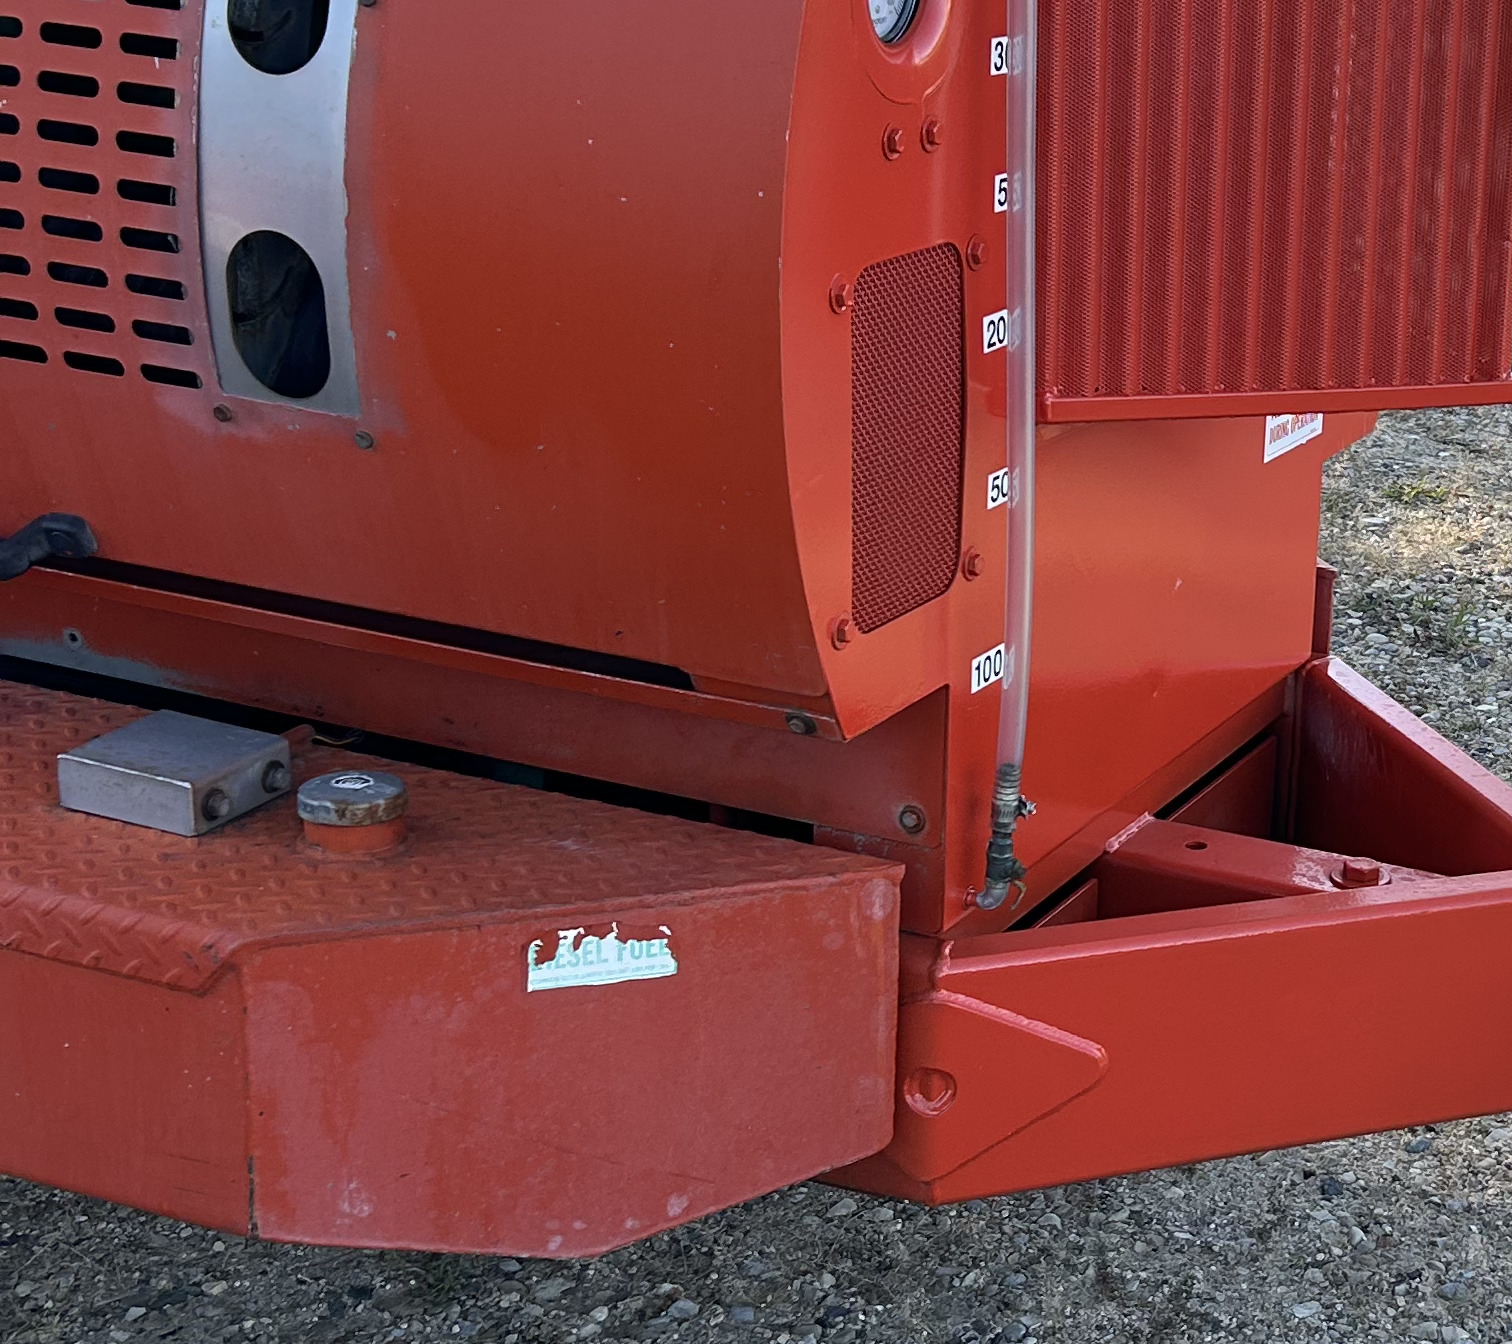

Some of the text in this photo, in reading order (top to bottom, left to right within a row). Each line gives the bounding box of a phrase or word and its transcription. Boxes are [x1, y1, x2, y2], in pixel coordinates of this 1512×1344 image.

[998, 177, 1008, 207] 5
[987, 315, 1006, 349] 20
[991, 470, 1008, 503] 50
[975, 649, 1002, 687] 100
